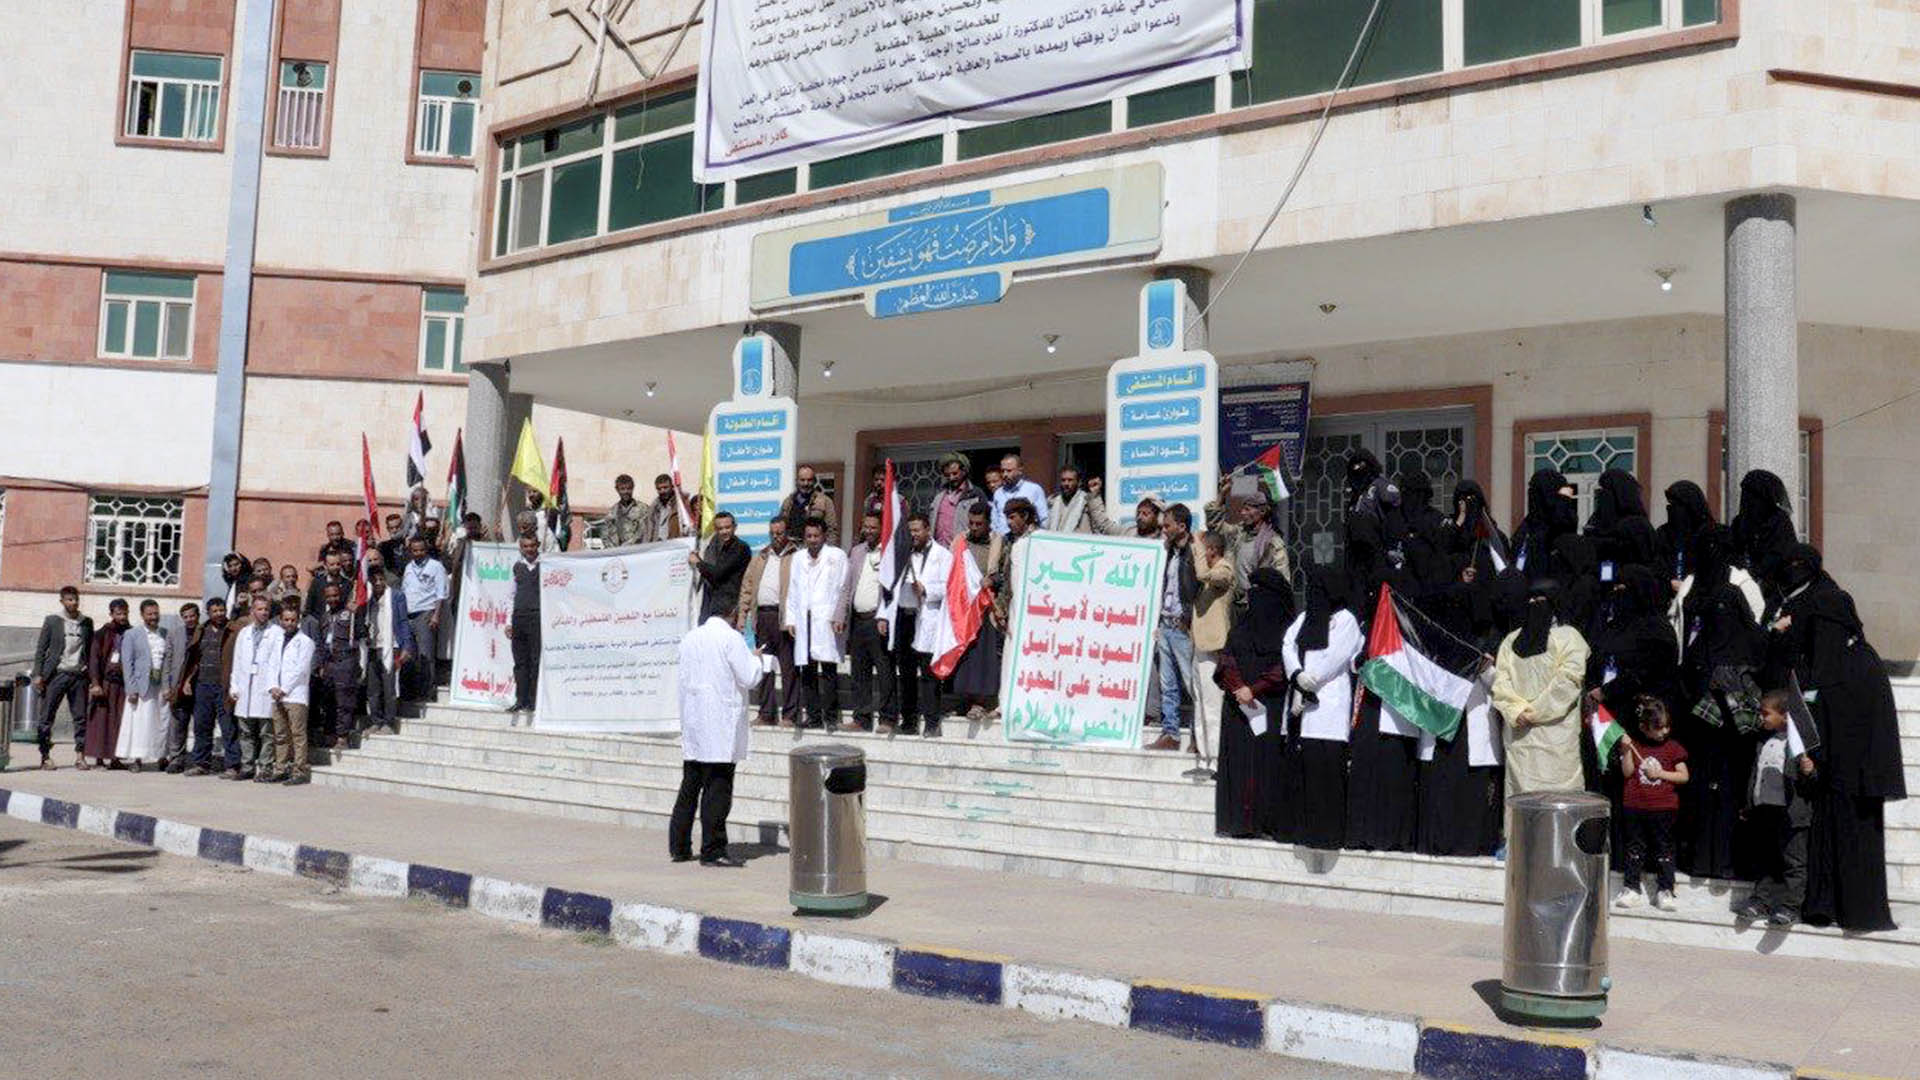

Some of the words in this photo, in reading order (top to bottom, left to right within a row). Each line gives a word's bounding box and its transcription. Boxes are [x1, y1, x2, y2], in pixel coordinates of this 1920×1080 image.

[1101, 0, 1126, 17] غاية
[954, 12, 999, 32] للخدمات
[1013, 16, 1054, 38] للدكتورة
[1123, 21, 1141, 35] الله
[1145, 12, 1180, 33] وندعوا
[875, 34, 912, 53] المقدمة
[918, 25, 951, 43] الطبية
[1072, 33, 1105, 49] يوفقها
[994, 49, 1030, 63] بالصحة
[1034, 39, 1068, 55] ويمدها
[1030, 546, 1104, 590] أكبر
[1104, 553, 1151, 588] الله
[1027, 593, 1089, 623] لأمريكا
[1093, 604, 1146, 629] الموت
[1088, 642, 1141, 666] الموت
[1017, 670, 1063, 694] اليهود
[1066, 673, 1090, 698] على
[1097, 674, 1137, 700] اللعنة
[1082, 708, 1134, 742] النصر
